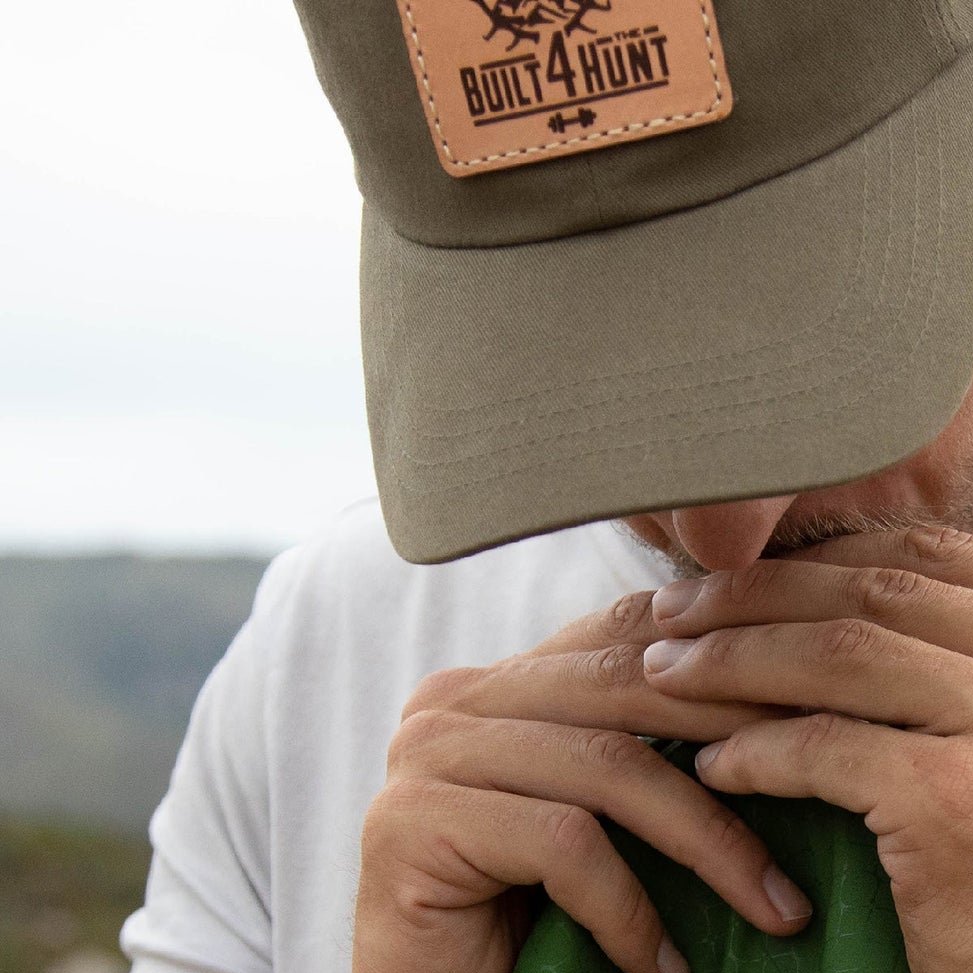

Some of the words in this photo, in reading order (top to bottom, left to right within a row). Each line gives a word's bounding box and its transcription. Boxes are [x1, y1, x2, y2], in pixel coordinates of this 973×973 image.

[614, 27, 641, 41] THE
[459, 60, 544, 118] BUILT
[546, 30, 577, 98] 4
[577, 35, 670, 94] HUNT
